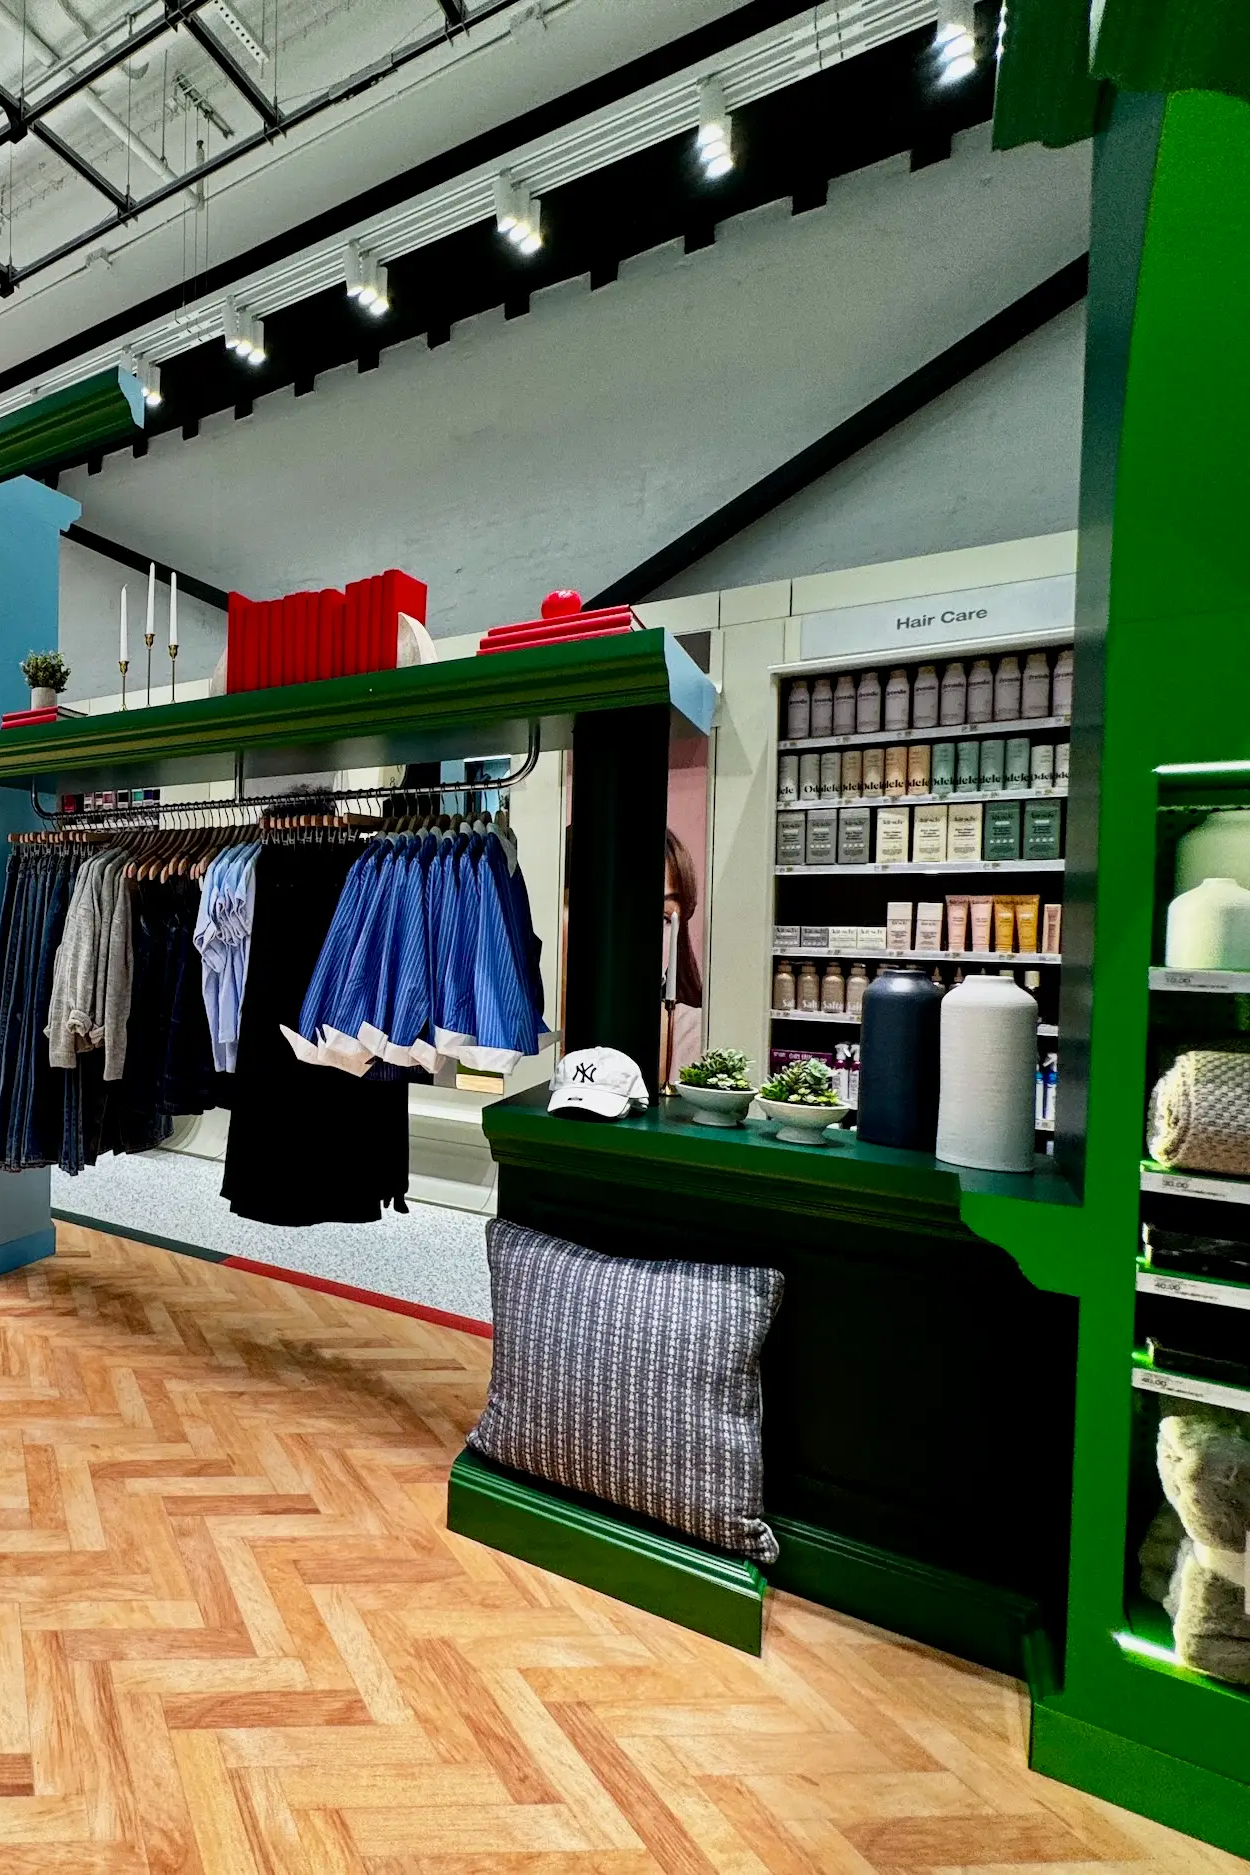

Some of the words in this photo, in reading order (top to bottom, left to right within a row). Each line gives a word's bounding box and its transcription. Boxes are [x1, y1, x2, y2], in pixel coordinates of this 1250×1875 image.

[897, 615, 935, 630] Hair
[941, 609, 988, 624] Care
[572, 1062, 597, 1084] NY
